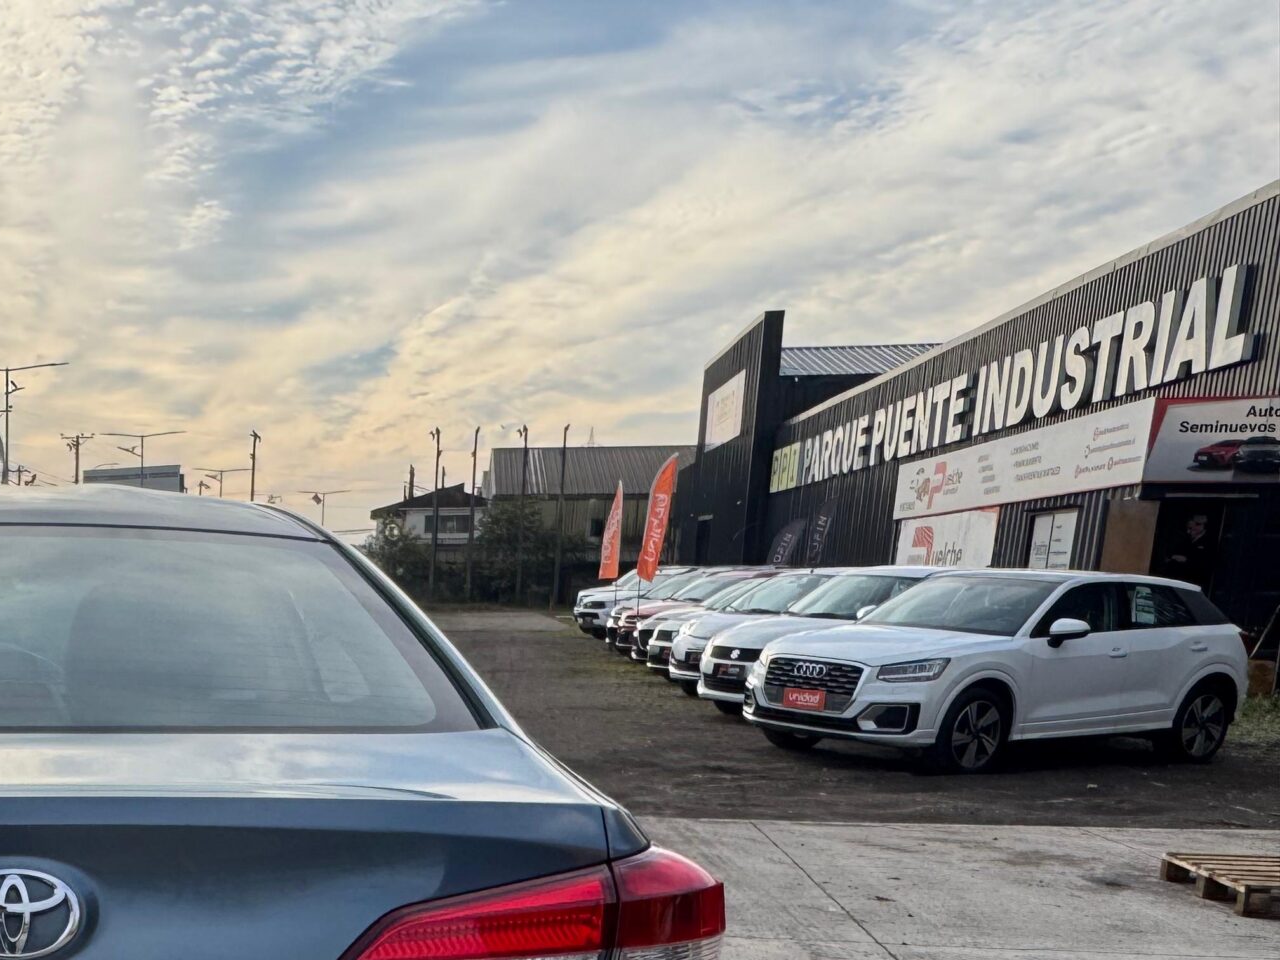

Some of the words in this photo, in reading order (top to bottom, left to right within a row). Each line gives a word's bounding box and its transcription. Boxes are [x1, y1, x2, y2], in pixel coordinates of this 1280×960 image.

[801, 414, 869, 486] PARQUE
[870, 373, 968, 466] PUENTE
[972, 264, 1250, 436] INDUSTRIAL
[1179, 420, 1276, 433] Seminuevos
